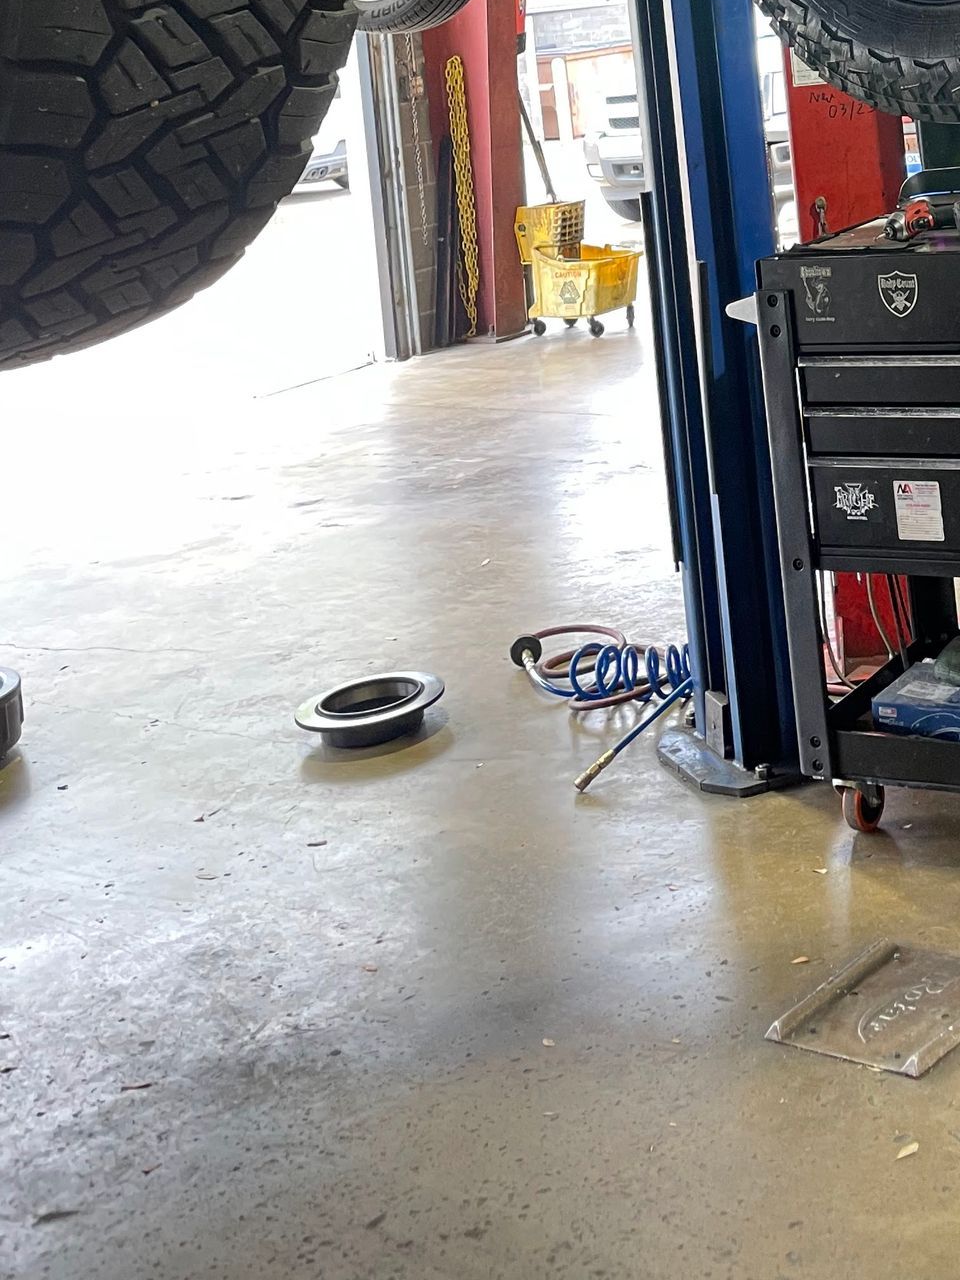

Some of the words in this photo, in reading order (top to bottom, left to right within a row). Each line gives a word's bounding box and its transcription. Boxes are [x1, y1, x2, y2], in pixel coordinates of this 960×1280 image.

[554, 270, 582, 279] CAUTION
[880, 278, 896, 290] Body
[897, 278, 916, 289] Count
